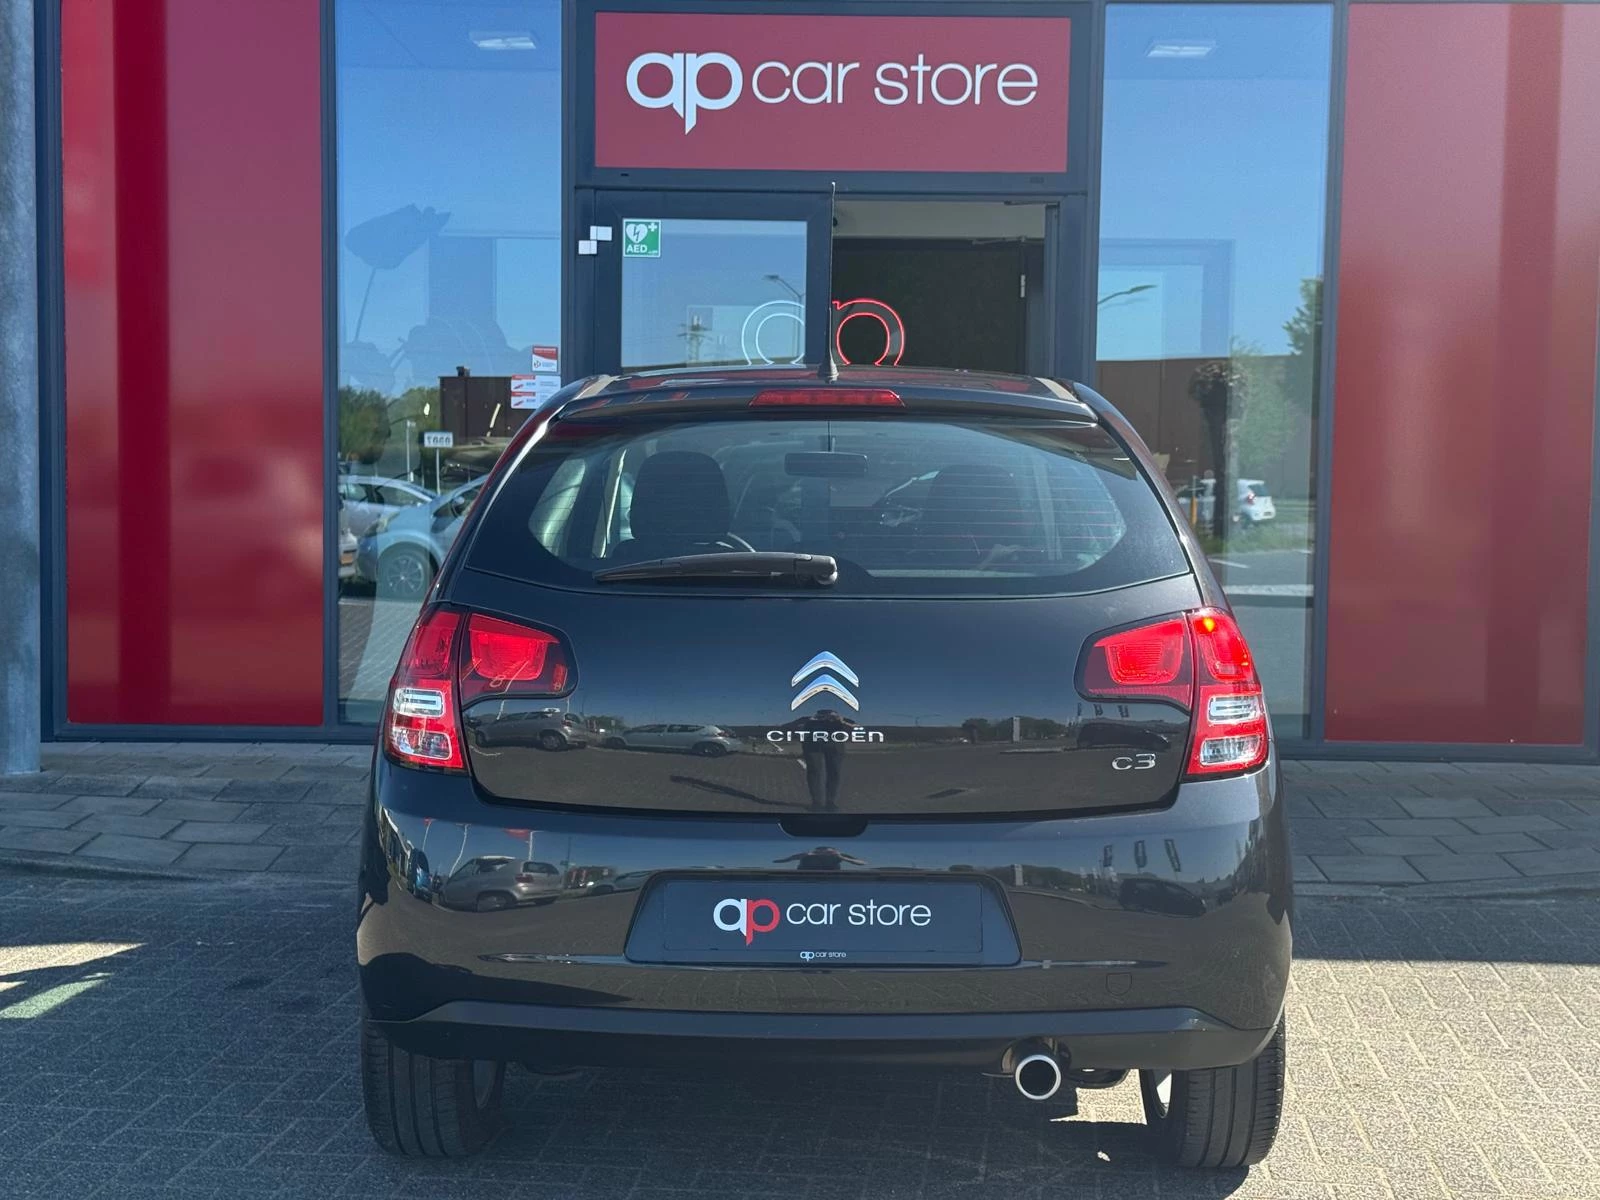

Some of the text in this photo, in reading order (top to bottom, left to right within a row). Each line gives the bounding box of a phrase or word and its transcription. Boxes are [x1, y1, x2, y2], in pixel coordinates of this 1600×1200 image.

[626, 51, 1039, 135] ap car store
[626, 245, 648, 253] AED
[1111, 753, 1157, 771] C3
[713, 898, 932, 946] ap car store
